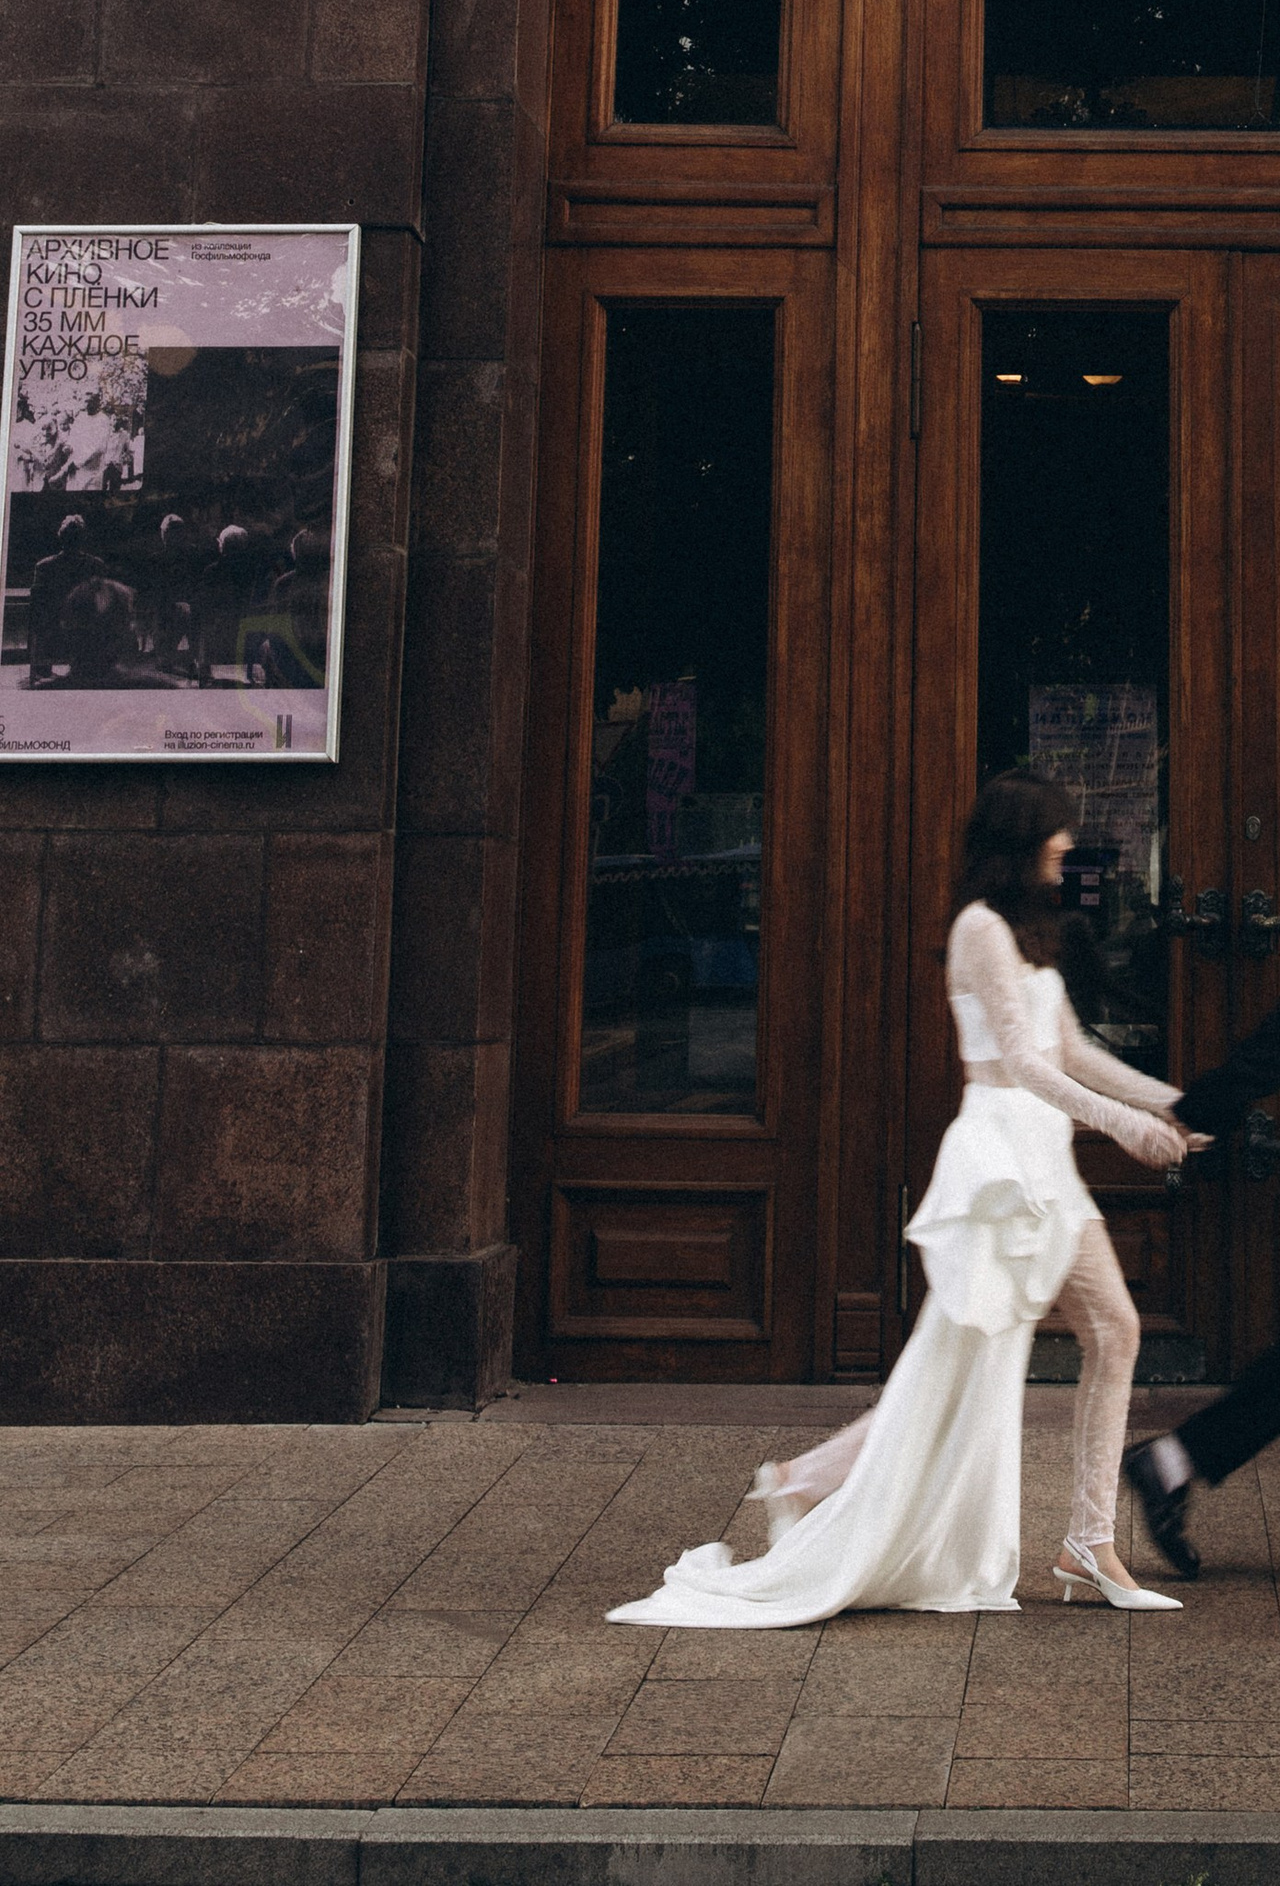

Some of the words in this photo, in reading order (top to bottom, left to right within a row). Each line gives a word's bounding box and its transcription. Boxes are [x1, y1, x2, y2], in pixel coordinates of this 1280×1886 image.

[27, 238, 170, 260] АРХИВНОЕ
[191, 251, 271, 262] Госфильмофонда
[27, 263, 103, 284] КИНО
[24, 287, 43, 308] С
[50, 281, 158, 308] ПЛЁНКИ
[23, 311, 52, 332] 35
[60, 311, 106, 332] ММ
[22, 335, 140, 360] КАЖДОЕ
[19, 359, 88, 381] УТРО
[165, 730, 188, 740] Вход
[189, 731, 202, 739] по
[203, 731, 263, 741] регистрации
